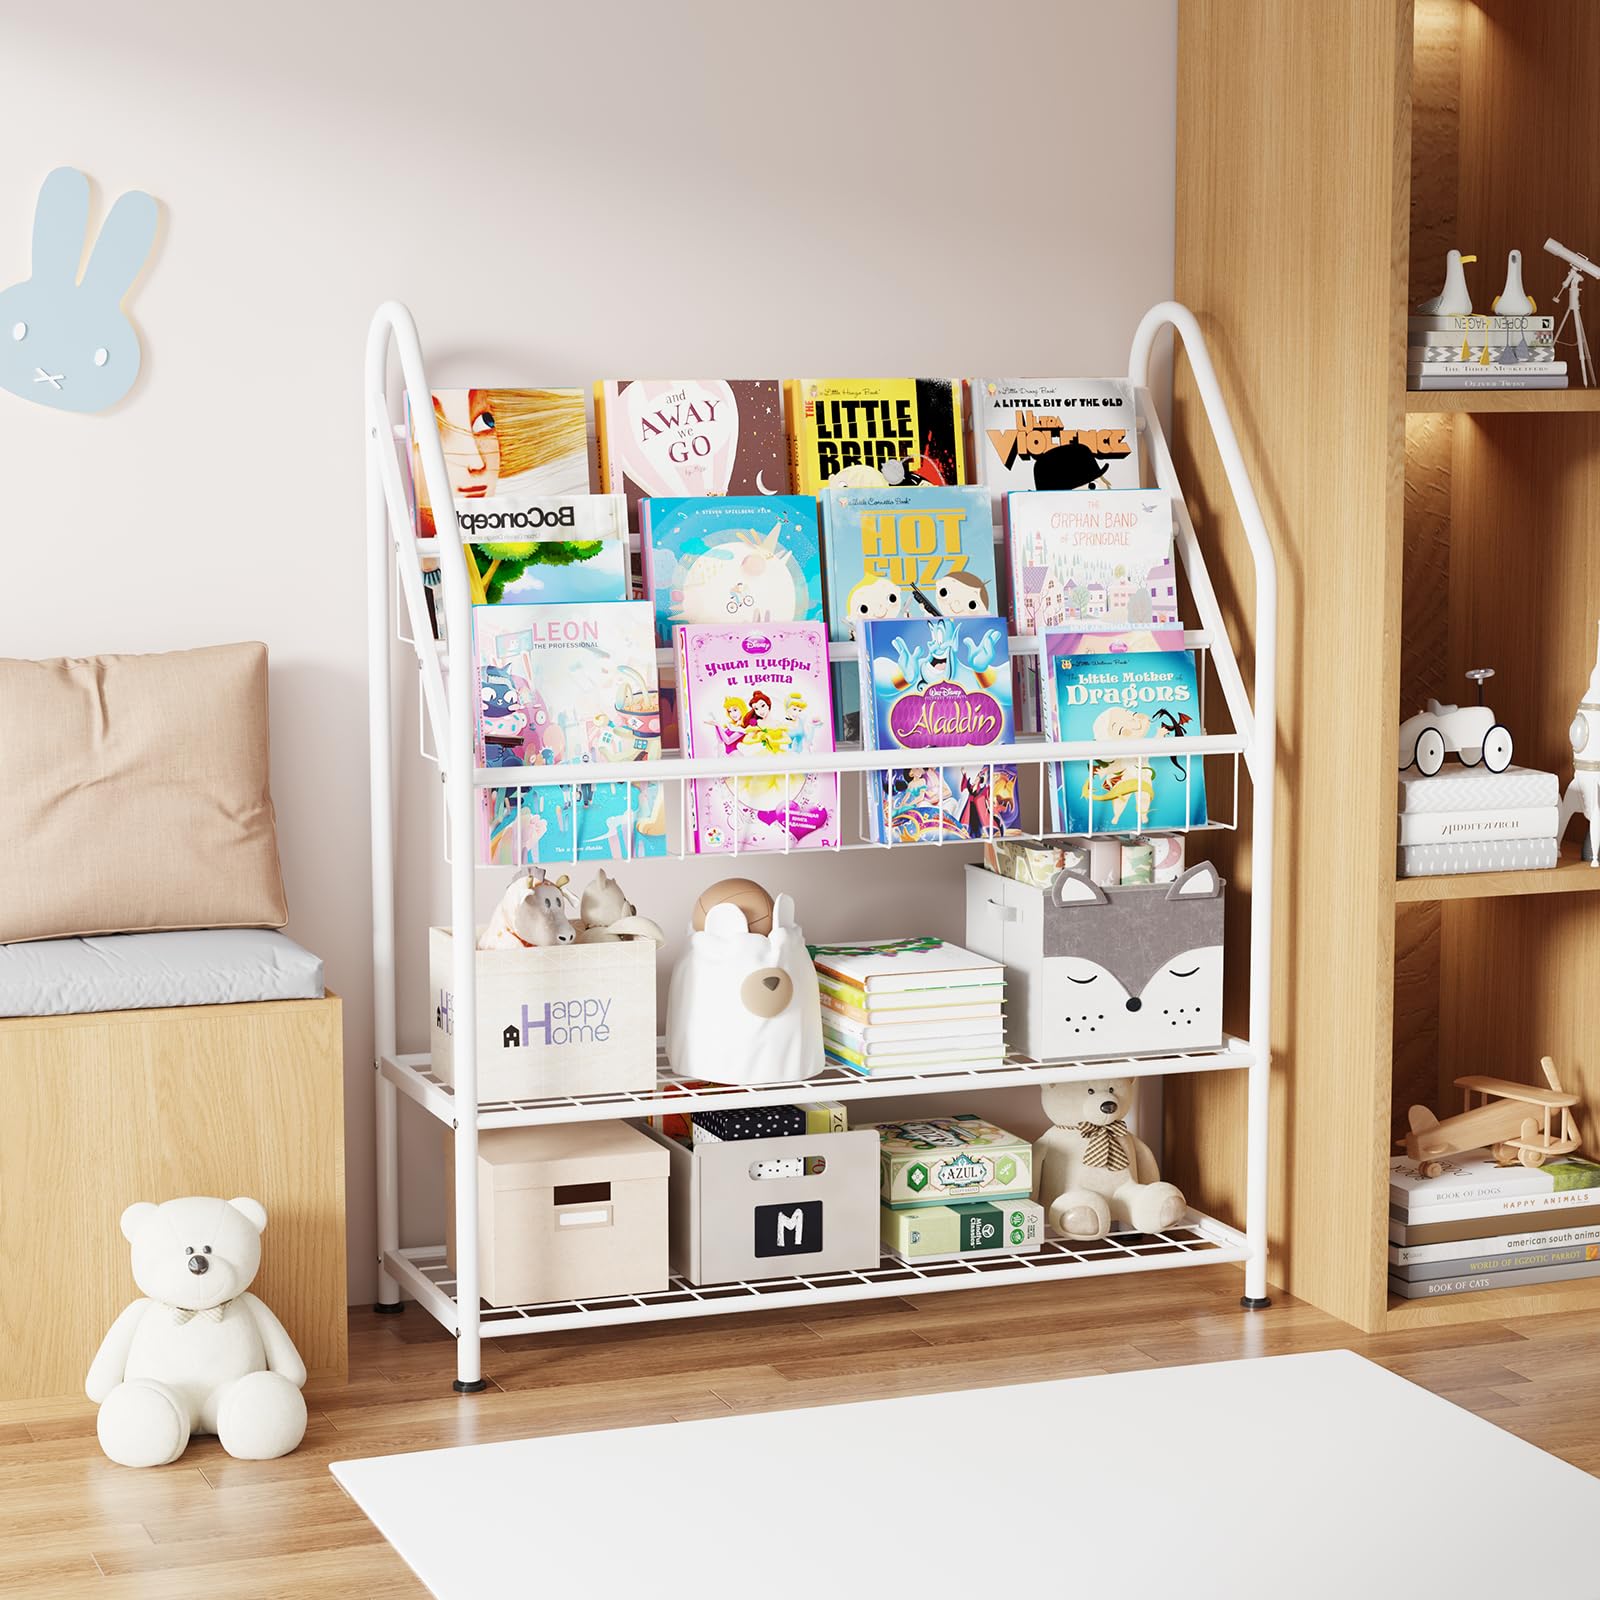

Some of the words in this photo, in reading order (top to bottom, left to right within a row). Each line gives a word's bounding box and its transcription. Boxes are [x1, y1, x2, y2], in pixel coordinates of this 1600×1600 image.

[1464, 379, 1498, 388] OLIVER
[1500, 379, 1527, 388] TWIST
[665, 388, 687, 405] and
[993, 399, 1001, 408] A
[1002, 398, 1042, 408] LITTLE
[1043, 398, 1060, 408] BIT
[1064, 398, 1078, 408] OF
[1080, 398, 1100, 408] THE
[1102, 397, 1124, 407] OLD
[805, 399, 815, 419] THE
[640, 399, 722, 442] AWAY
[815, 400, 914, 439] LITTLE
[677, 426, 695, 440] we
[668, 435, 712, 464] GO
[1050, 511, 1100, 529] ORPHAN
[1104, 511, 1138, 529] BAND
[860, 514, 968, 556] HOT
[1072, 530, 1131, 547] SPRINGDALE
[532, 619, 600, 642] LEON
[548, 641, 599, 650] PROFESSIONAL
[746, 639, 771, 651] Disney
[755, 656, 812, 672] цифры
[727, 677, 739, 686] и
[743, 674, 794, 687] цвета
[1077, 672, 1120, 686] Little
[1121, 671, 1175, 684] Mother
[1065, 684, 1192, 709] Dragons
[897, 700, 997, 738] Aladdin
[946, 1166, 978, 1180] AZUL
[1436, 1191, 1460, 1201] BOOK
[1463, 1190, 1475, 1198] OF
[1477, 1187, 1502, 1197] DOGS
[1503, 1199, 1536, 1209] HAPPY
[1543, 1193, 1590, 1206] ANIMALS
[776, 1208, 804, 1248] M
[1507, 1236, 1547, 1248] american
[1548, 1232, 1573, 1243] south
[1470, 1260, 1499, 1271] WORLD
[1501, 1258, 1512, 1268] OF
[1551, 1250, 1582, 1261] PARROT
[1428, 1283, 1453, 1294] BOOK
[1455, 1280, 1467, 1290] OF
[1468, 1278, 1490, 1289] CATS
